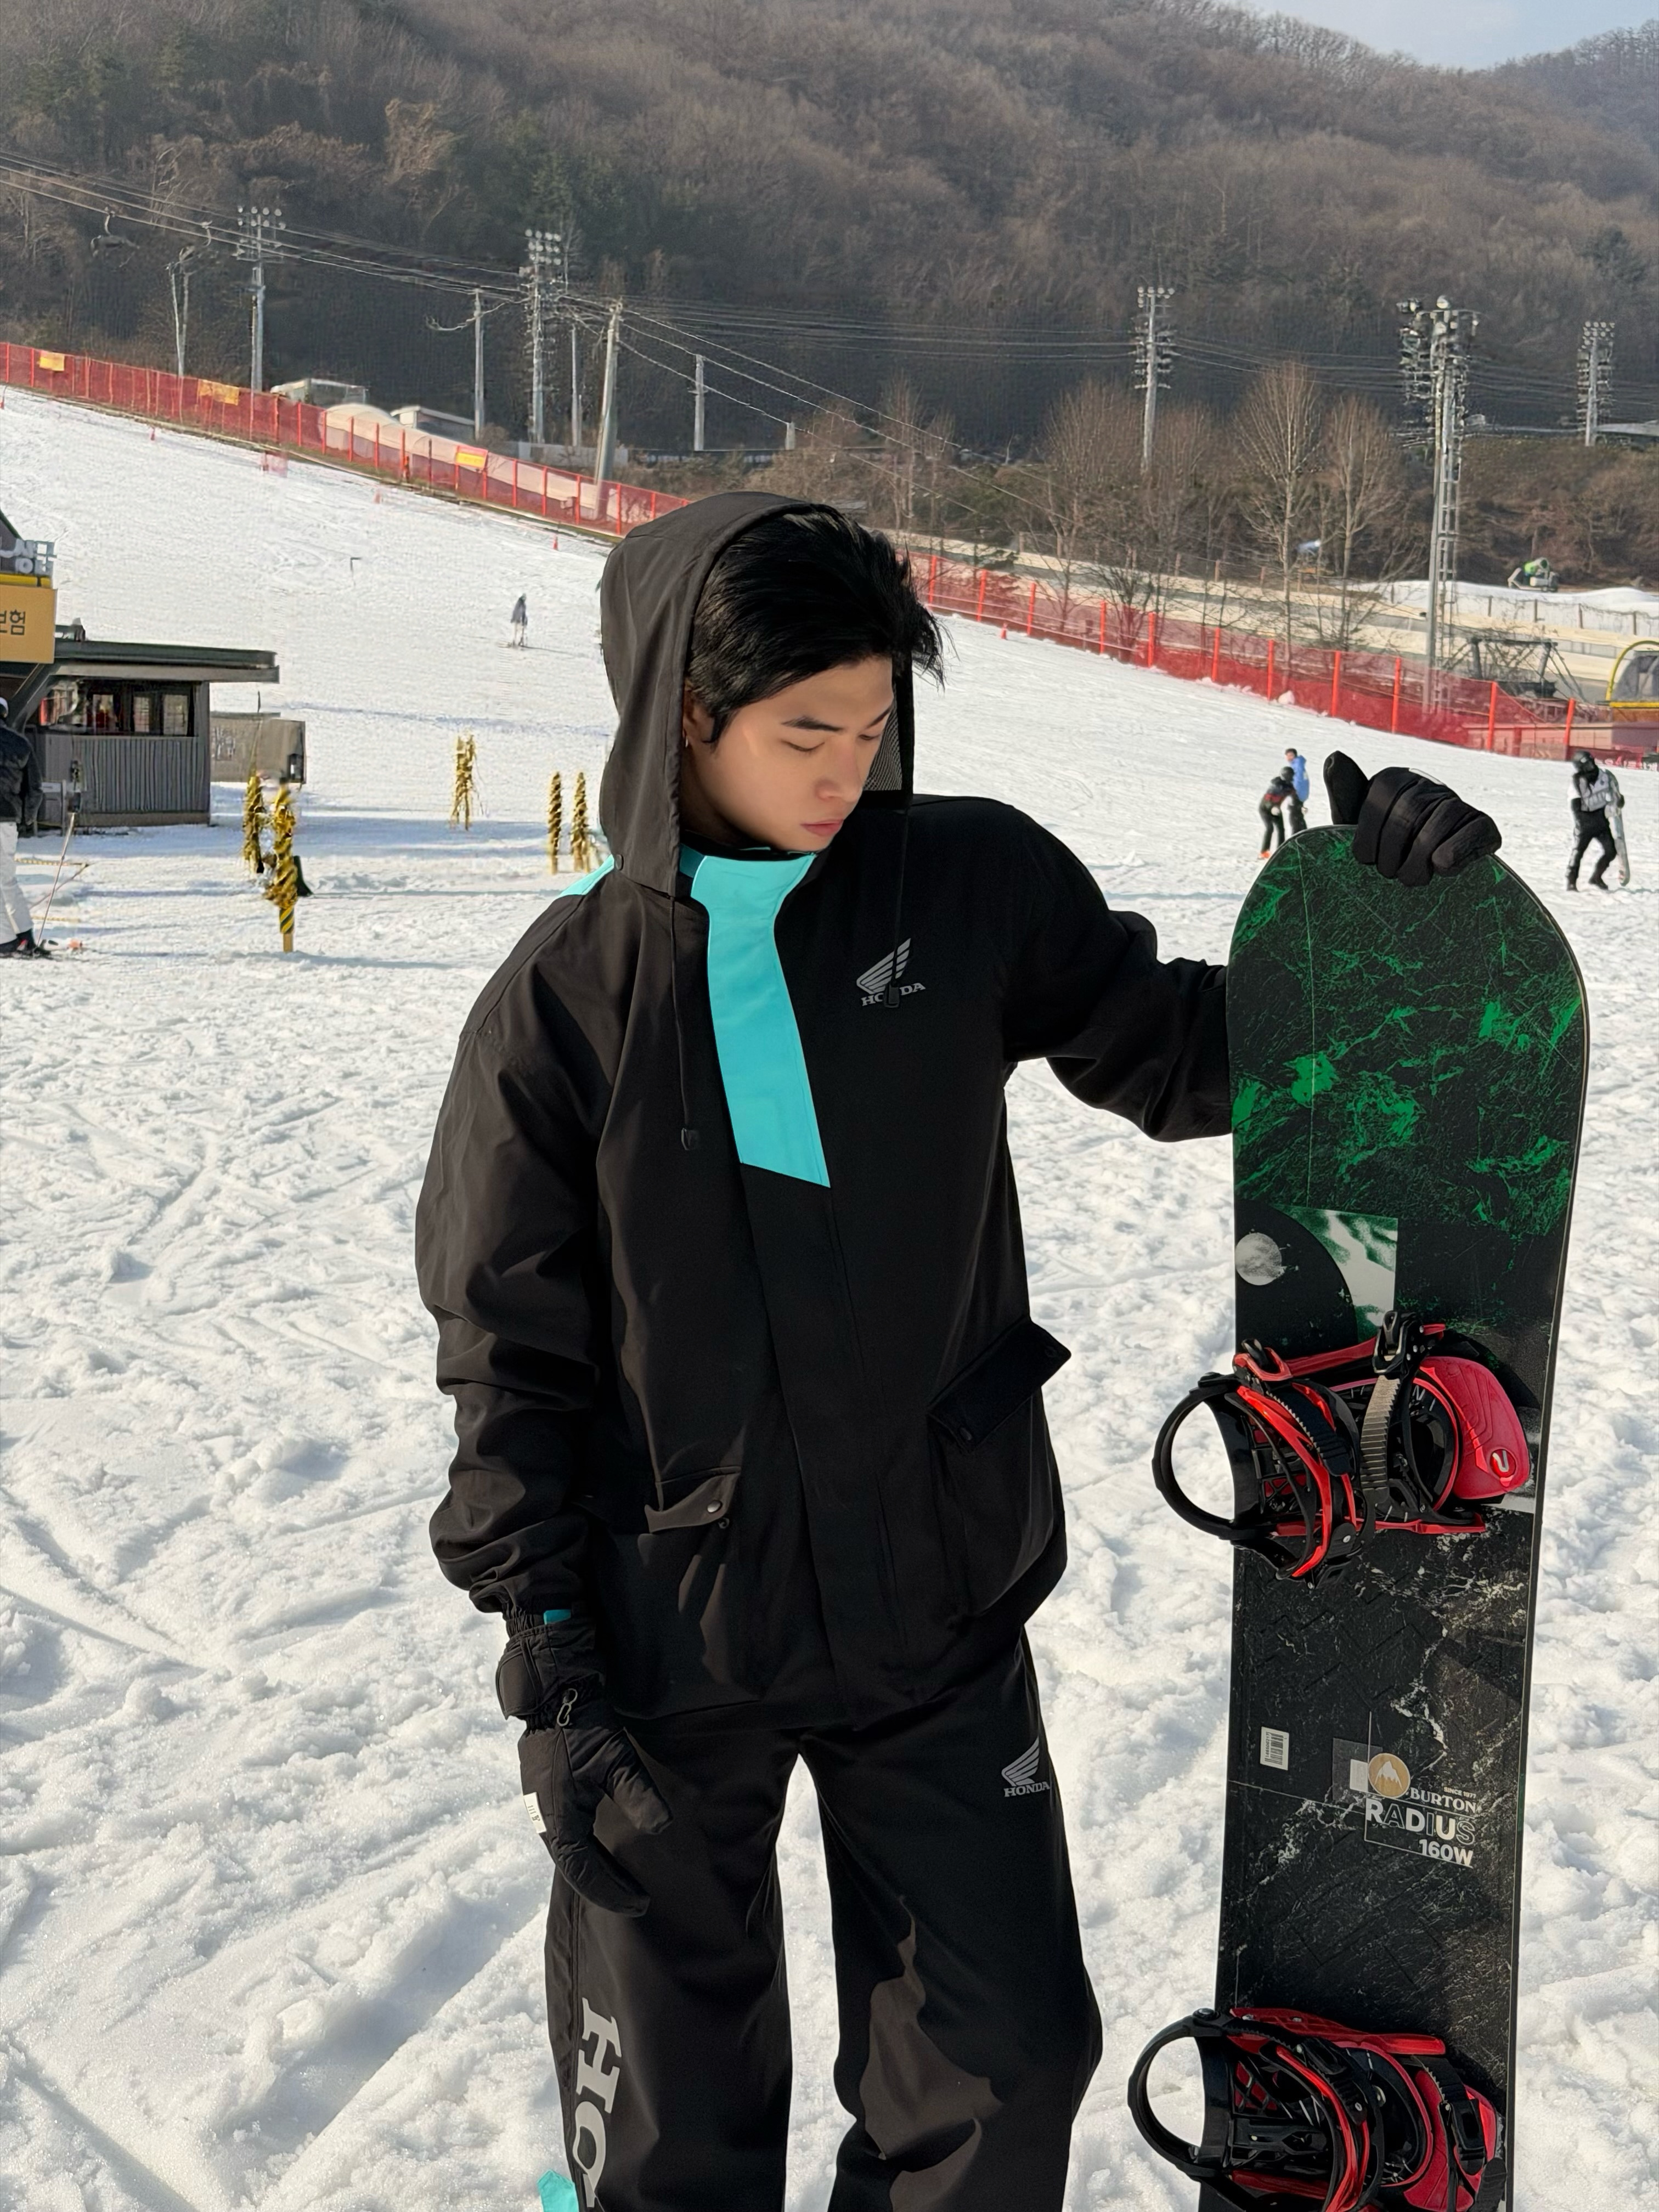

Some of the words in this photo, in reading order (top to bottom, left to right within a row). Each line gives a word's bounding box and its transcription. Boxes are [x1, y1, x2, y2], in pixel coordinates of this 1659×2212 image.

[860, 983, 926, 1007] HODA
[1003, 1781, 1050, 1797] HONDA
[1410, 1787, 1476, 1814] BURTON
[1443, 1786, 1463, 1796] SINCE
[1365, 1798, 1476, 1846] RADIUS
[1419, 1839, 1474, 1866] 160W
[572, 1996, 622, 2208] HO
